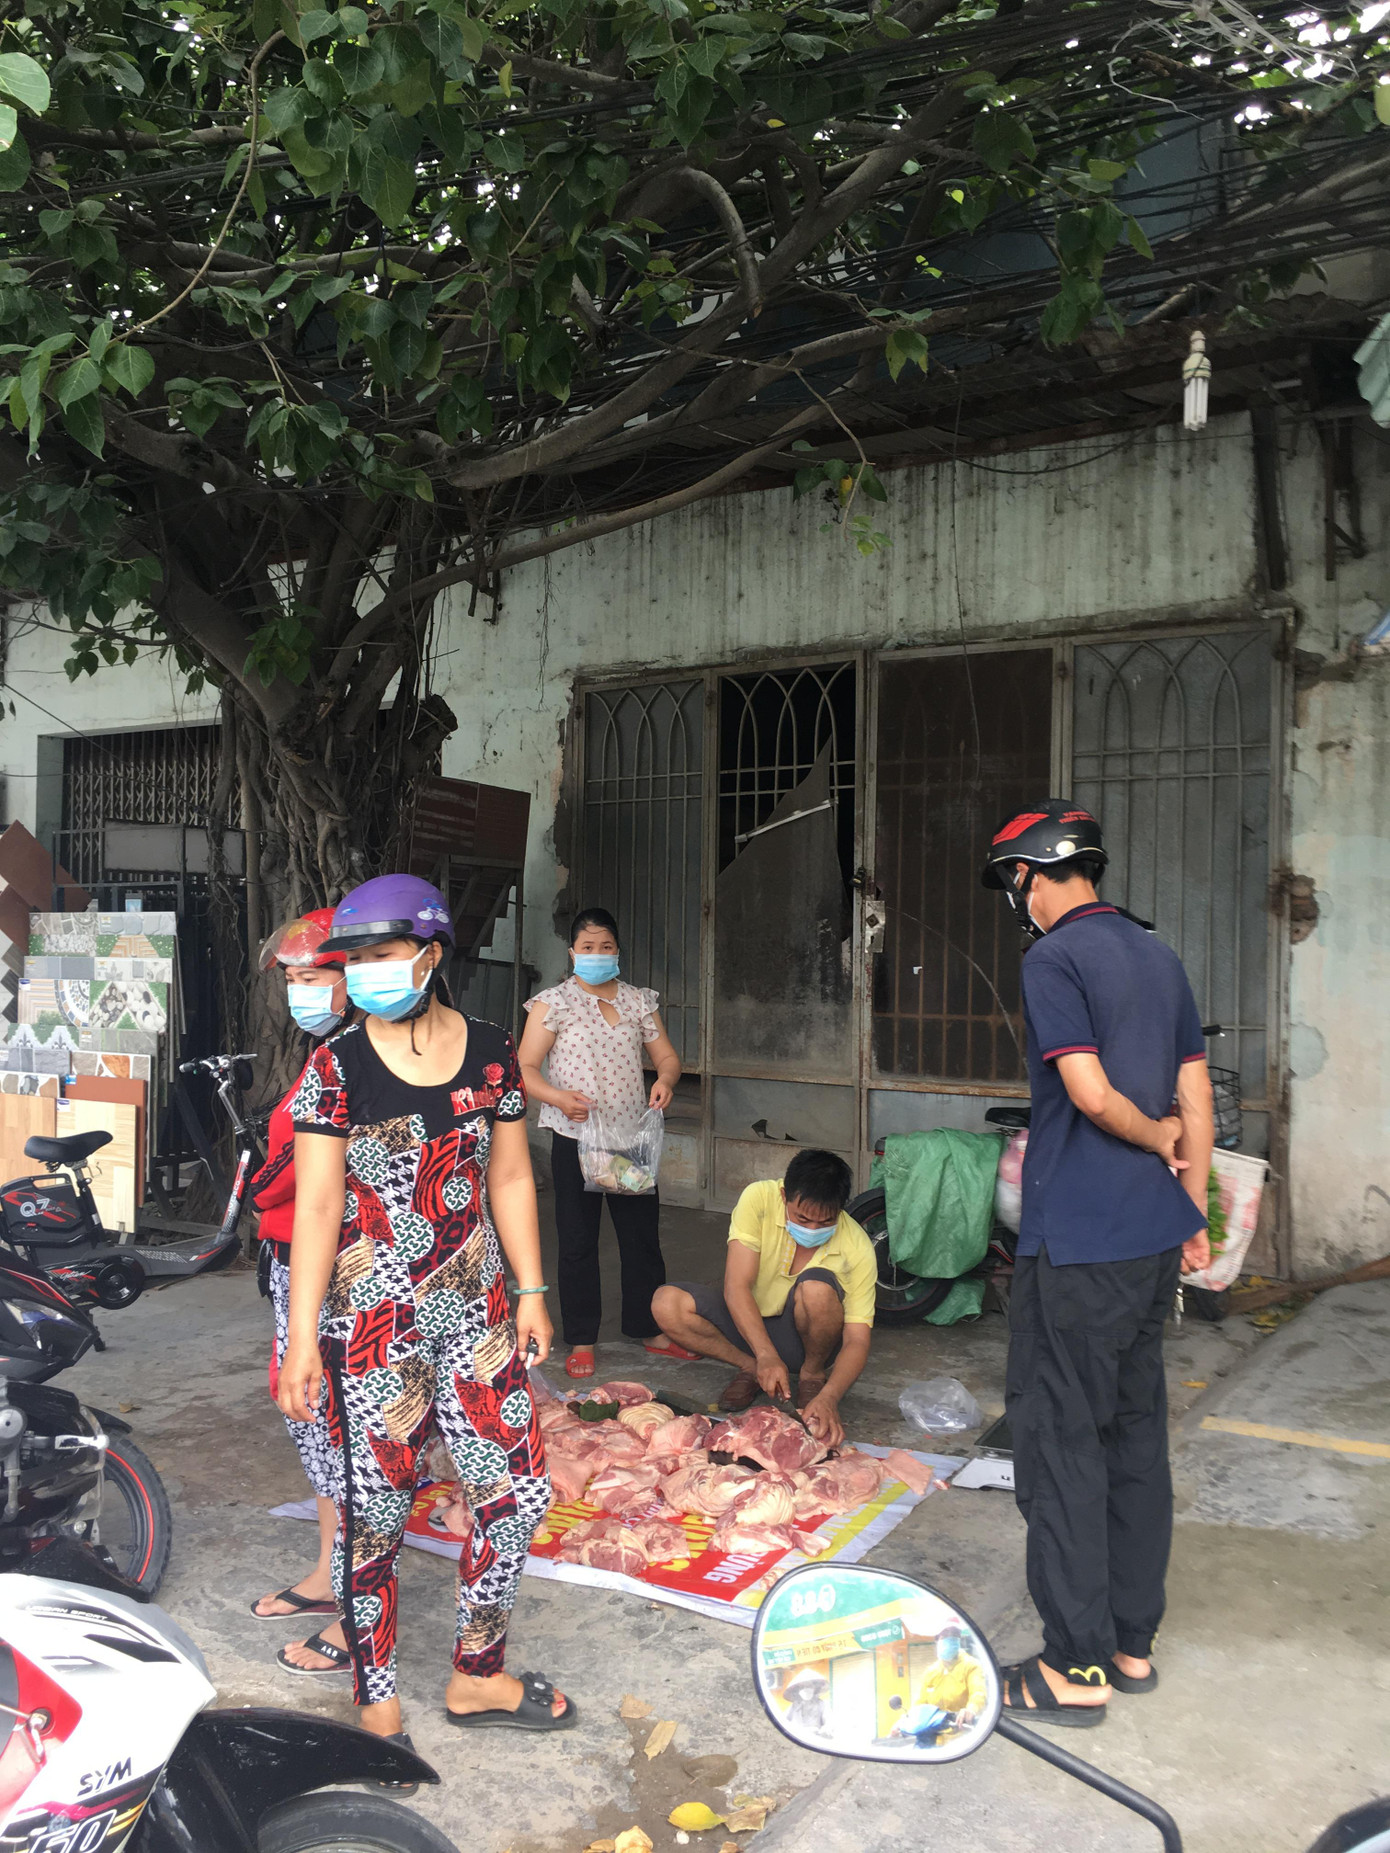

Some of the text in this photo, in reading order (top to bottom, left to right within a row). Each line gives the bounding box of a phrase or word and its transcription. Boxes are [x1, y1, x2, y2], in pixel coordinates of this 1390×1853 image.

[20, 1198, 50, 1217] Q7
[25, 1604, 108, 1621] URBAN SPORT
[77, 1757, 132, 1797] SYM
